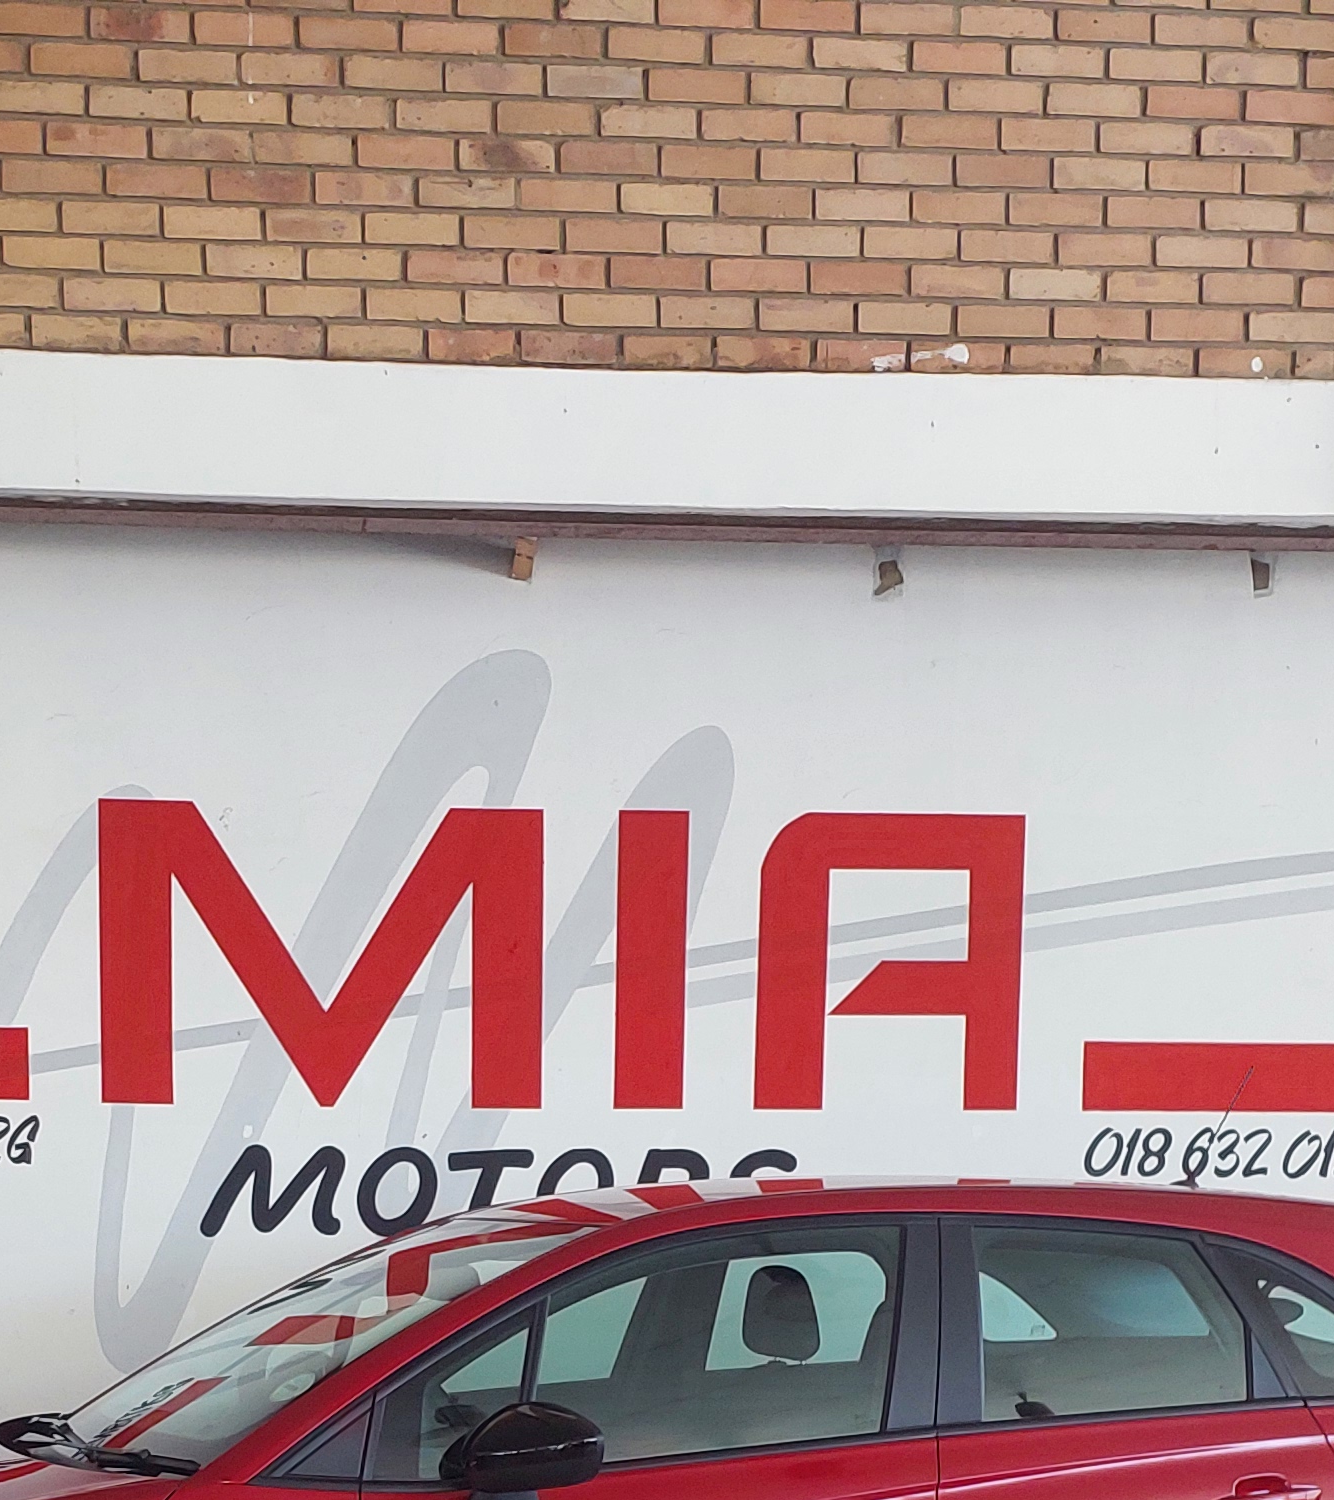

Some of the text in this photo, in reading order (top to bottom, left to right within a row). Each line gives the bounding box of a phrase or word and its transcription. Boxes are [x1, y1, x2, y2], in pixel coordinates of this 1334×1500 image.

[98, 797, 1026, 1110] MIA
[199, 1144, 799, 1238] MOT
[1083, 1127, 1173, 1177] 018
[1181, 1127, 1272, 1178] 632
